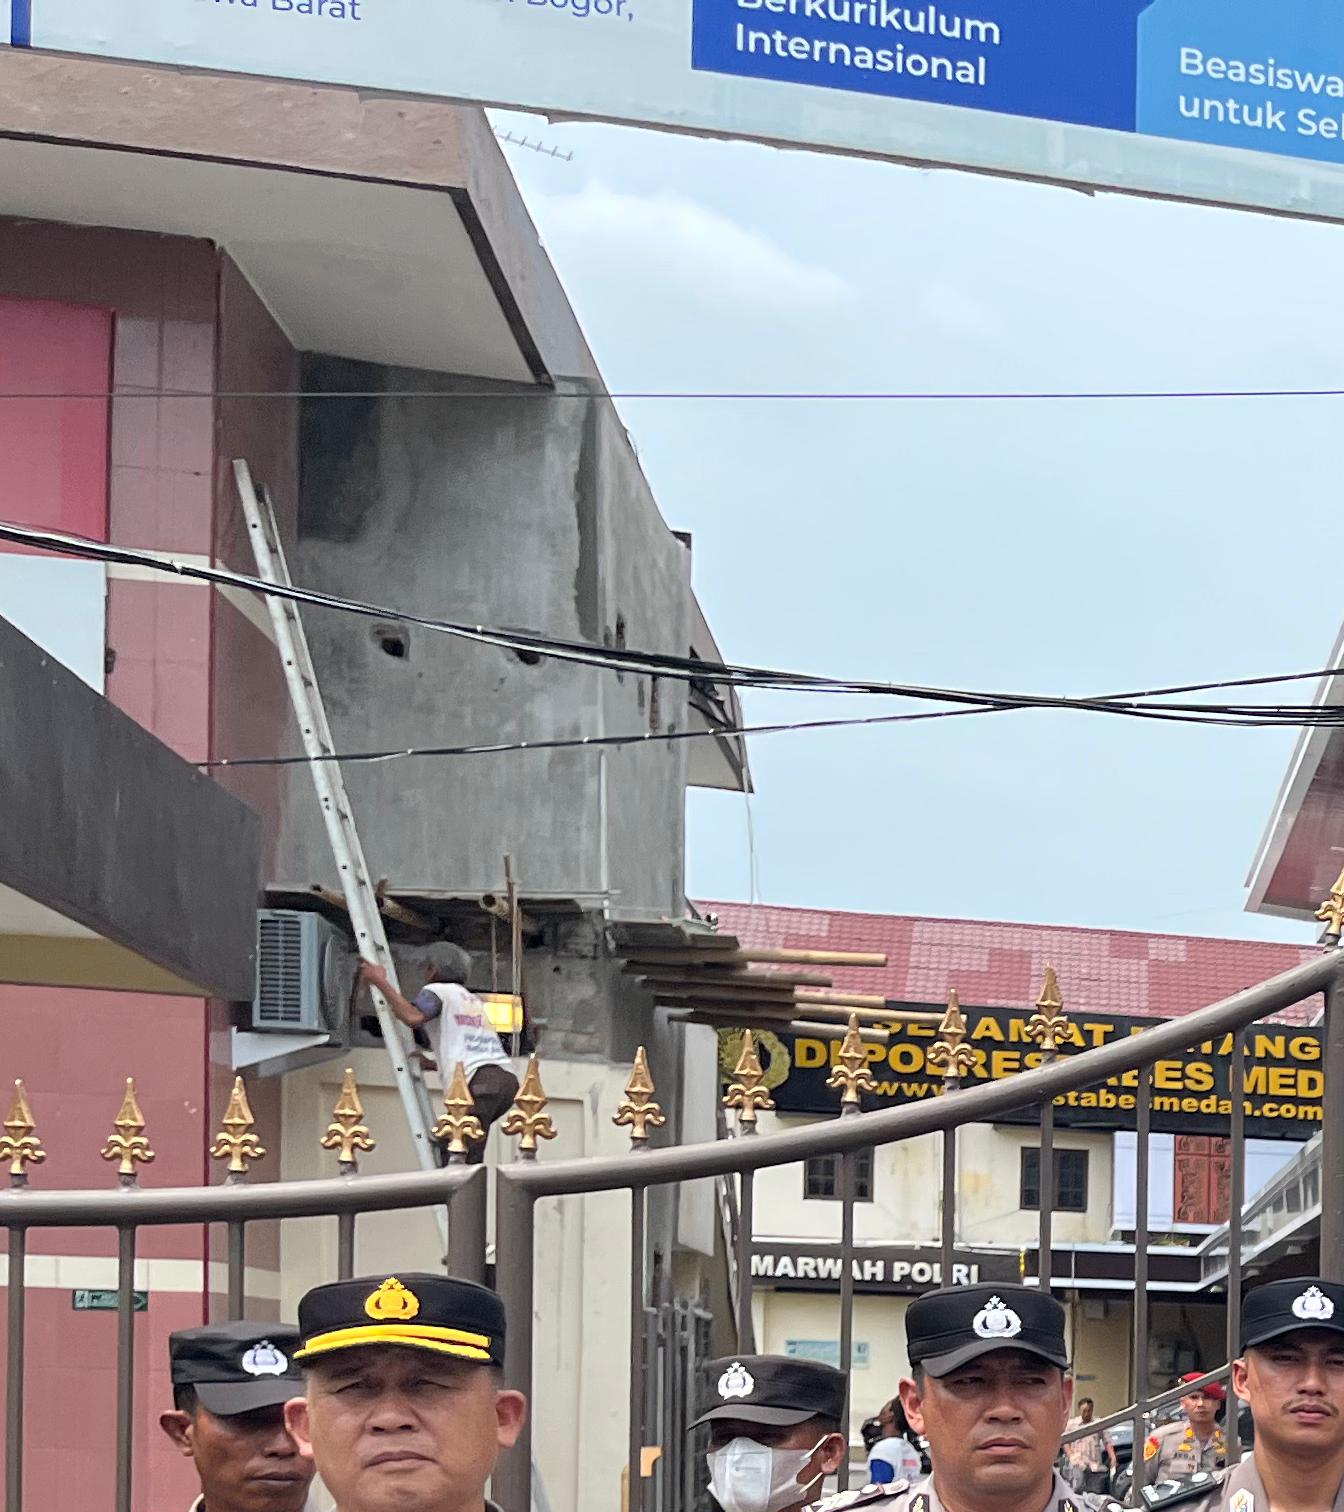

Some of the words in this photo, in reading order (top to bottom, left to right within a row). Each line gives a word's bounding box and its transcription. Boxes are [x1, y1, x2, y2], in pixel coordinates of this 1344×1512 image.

[272, 0, 361, 20] Barat
[527, 0, 633, 21] ogor,
[736, 23, 987, 85] Internasional
[1180, 47, 1344, 98] Beasiswa
[1179, 94, 1286, 131] untuk
[751, 1254, 885, 1281] MARWAH
